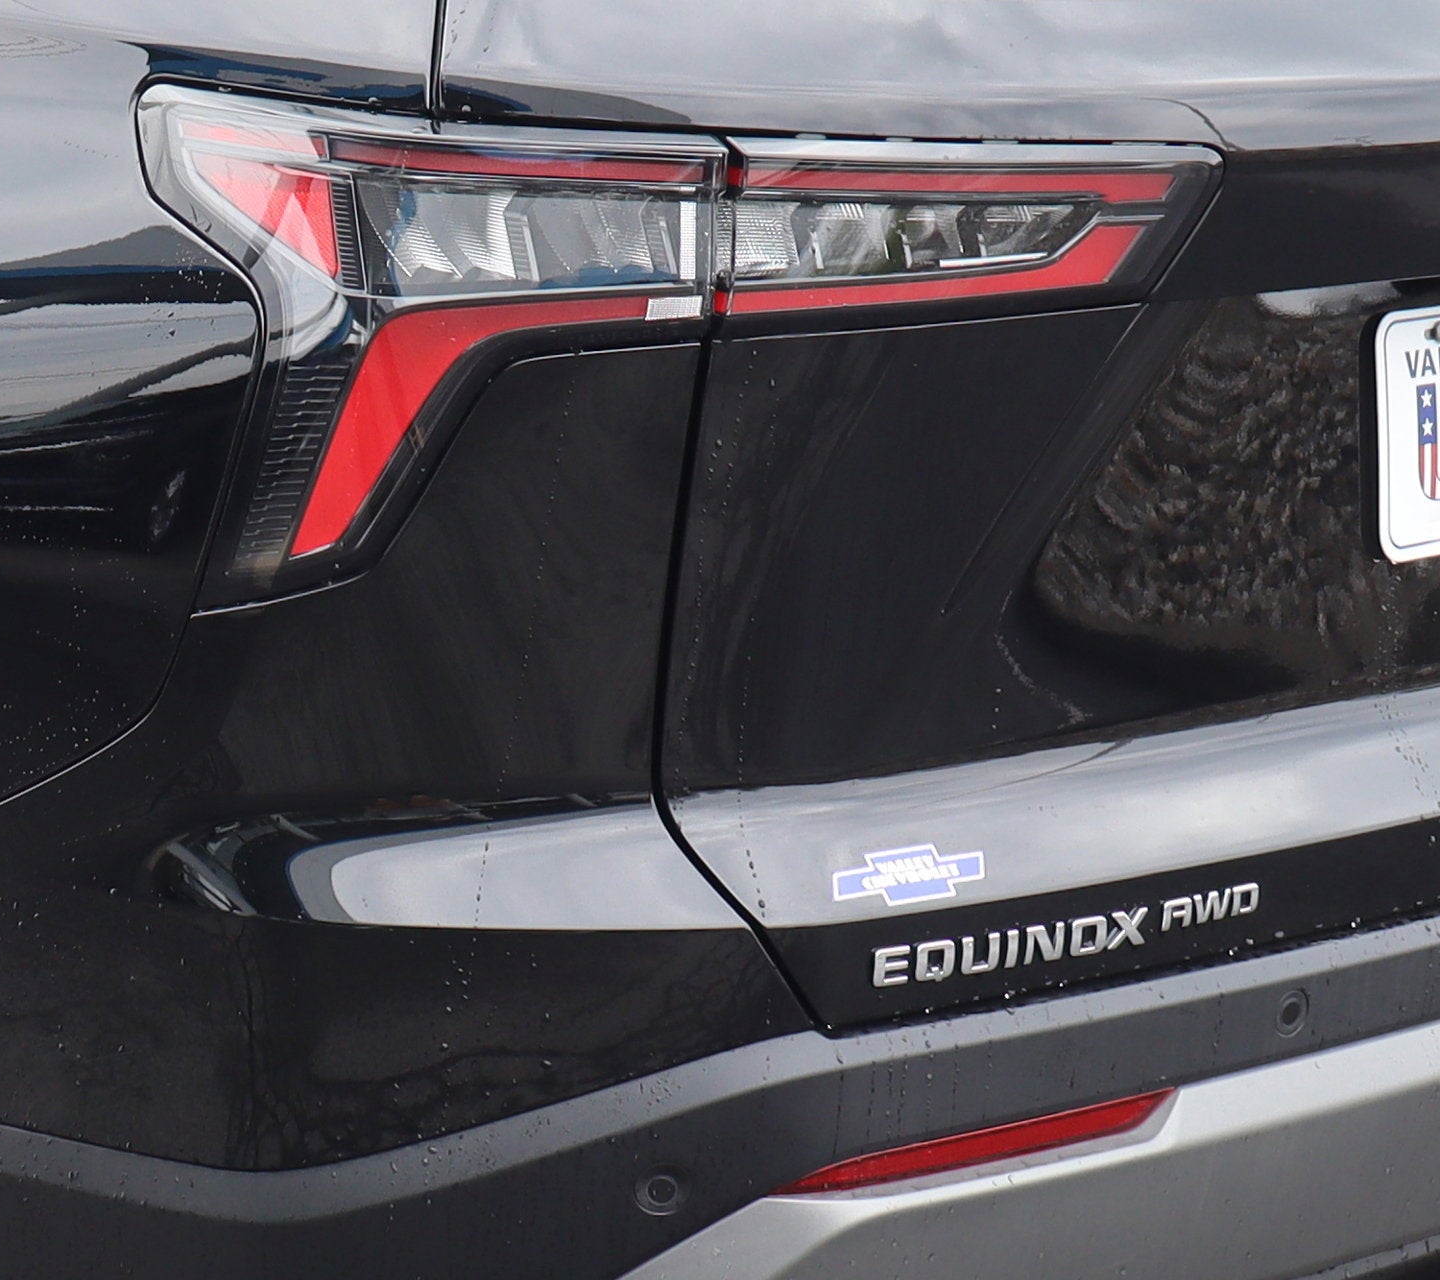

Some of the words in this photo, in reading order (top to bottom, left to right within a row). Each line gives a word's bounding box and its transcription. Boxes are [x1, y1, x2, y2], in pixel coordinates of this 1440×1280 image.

[860, 862, 962, 891] CHEVROLET
[873, 854, 936, 876] VALLEY
[872, 906, 1149, 989] EQUINOX
[1160, 881, 1260, 933] AWD
